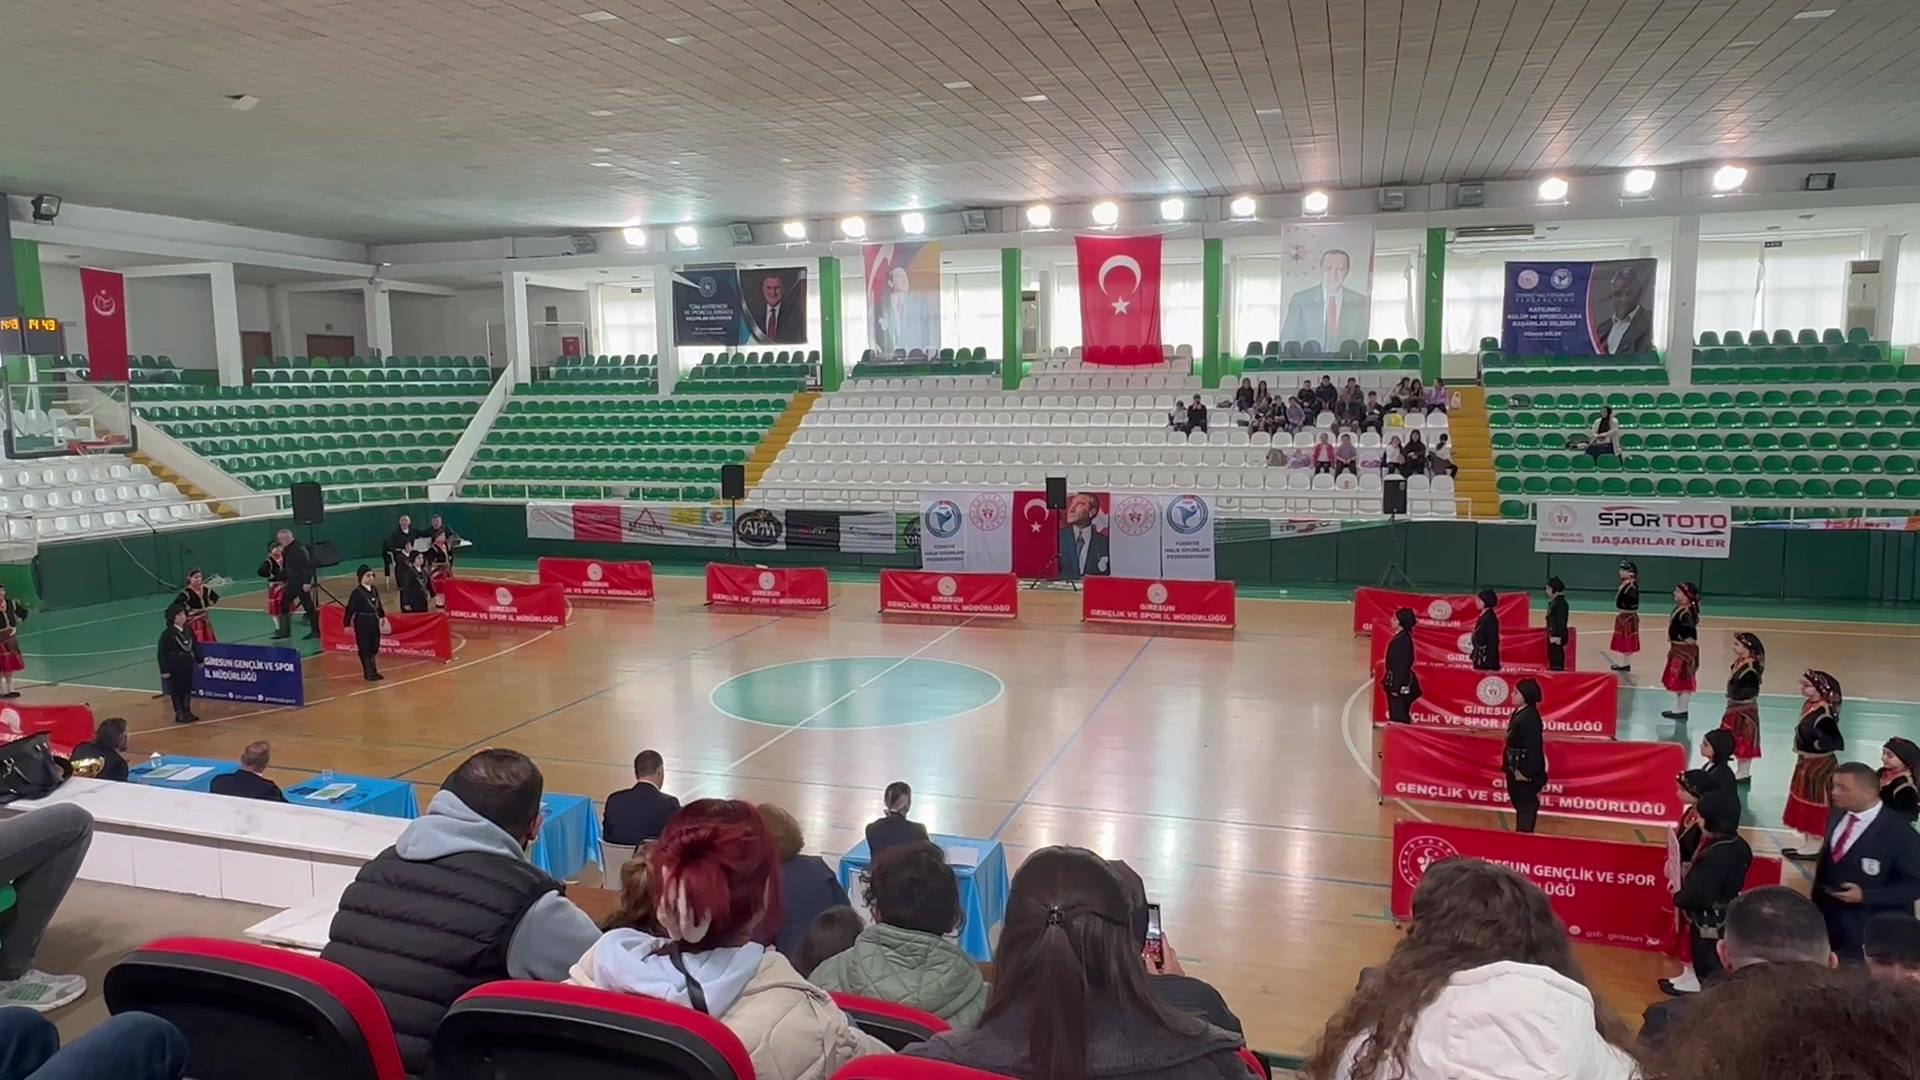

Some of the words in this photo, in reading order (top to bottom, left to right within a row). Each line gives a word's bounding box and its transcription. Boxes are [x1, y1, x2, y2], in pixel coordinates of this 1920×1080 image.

[1591, 535, 1676, 547] BAŞARILAR
[1680, 535, 1725, 548] DİLER
[265, 662, 274, 671] VE
[274, 662, 295, 672] SPOR
[1444, 716, 1462, 725] VE
[1464, 717, 1499, 728] SPOR
[1467, 789, 1489, 801] VE
[1559, 796, 1666, 816] MÜDÜRLÜĞÜ
[1533, 864, 1595, 882] GENÇLİK
[1596, 871, 1615, 884] VE
[1617, 872, 1656, 887] SPOR
